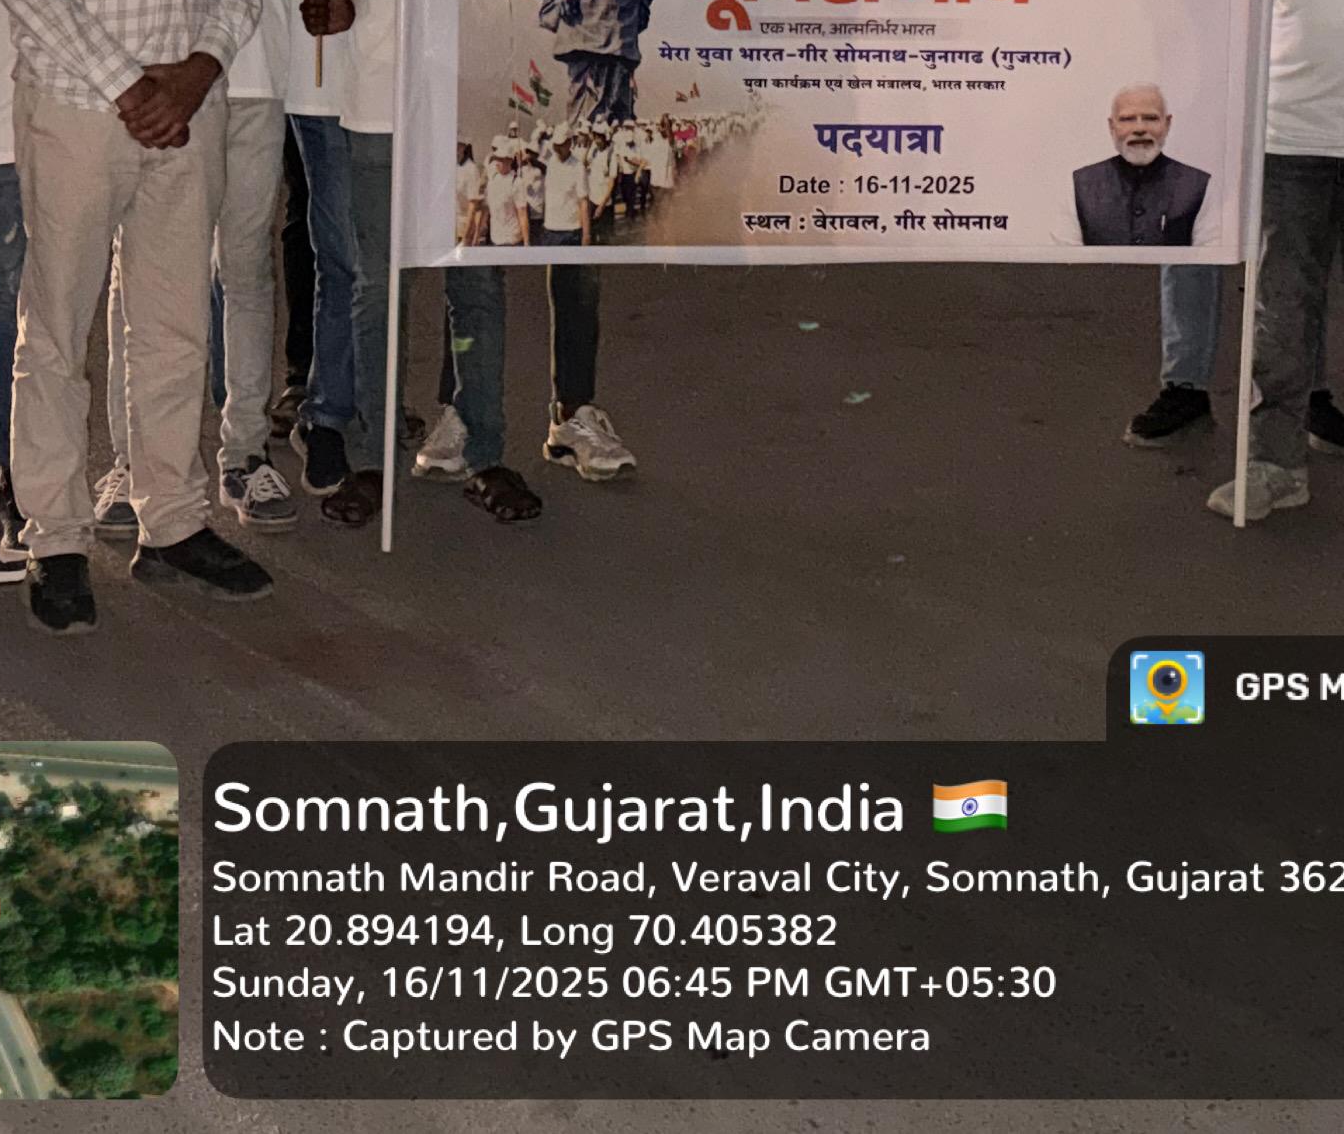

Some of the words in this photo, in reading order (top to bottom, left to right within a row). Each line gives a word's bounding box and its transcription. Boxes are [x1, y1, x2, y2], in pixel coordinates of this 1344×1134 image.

[760, 22, 785, 34] एक
[788, 22, 826, 36] भारत,
[830, 19, 899, 35] आत्मनिर्भर
[902, 23, 936, 35] भारत
[658, 41, 690, 61] मेरा
[696, 47, 732, 67] युवा
[739, 44, 828, 63] भारत-गीर
[991, 46, 1072, 70] (गुजरात)
[744, 77, 768, 92] युवा
[771, 74, 821, 89] कार्यक्रम
[847, 76, 872, 90] खेल
[932, 79, 962, 91] भारत
[966, 79, 1006, 91] सरकार
[812, 123, 944, 157] पदयात्रा
[779, 175, 831, 194] Date
[854, 175, 975, 194] 16-11-2025
[743, 213, 791, 232] स्थल
[812, 208, 887, 233] वेरावल,
[894, 209, 926, 231] गीर
[931, 208, 1008, 231] सोमनाथ
